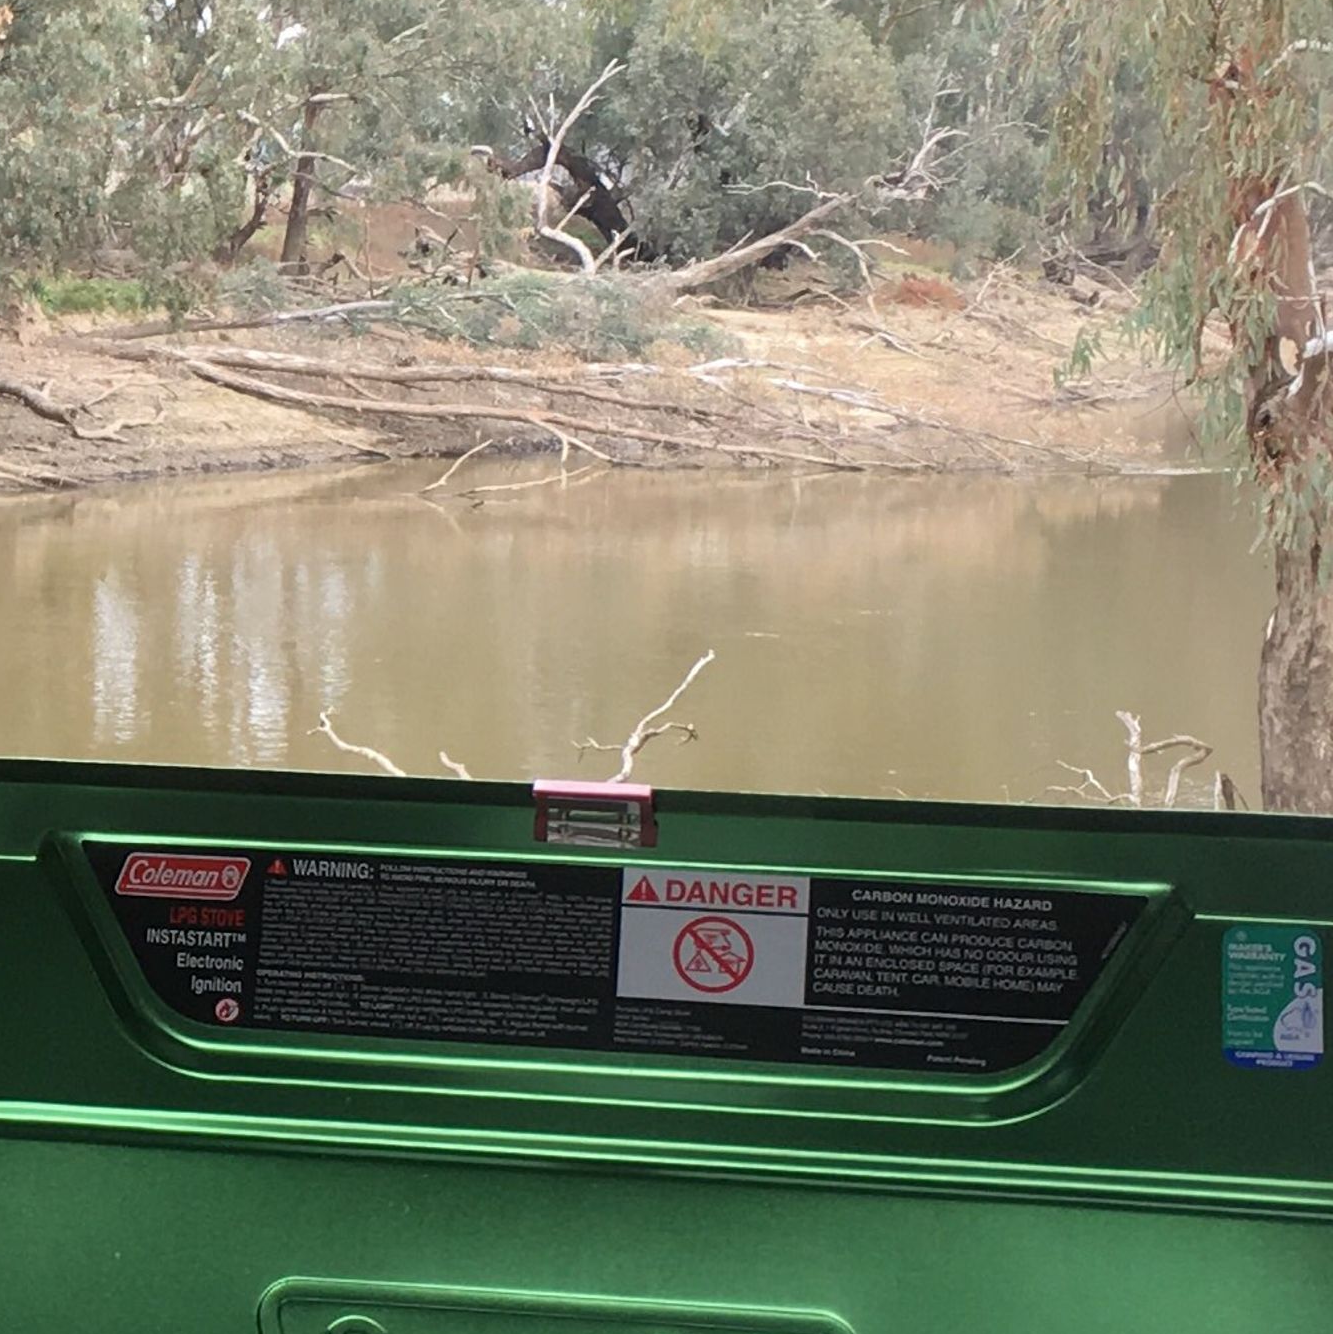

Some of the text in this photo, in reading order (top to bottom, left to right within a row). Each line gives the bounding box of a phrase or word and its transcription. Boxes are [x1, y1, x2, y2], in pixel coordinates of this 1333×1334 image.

[129, 860, 219, 888] Coleman
[292, 859, 374, 880] WARNING:
[665, 879, 798, 908] DANGER
[851, 889, 1052, 911] CARBON MONOXIDE HAZARD
[169, 906, 245, 927] LPG STOVE
[816, 906, 849, 919] ONLY
[852, 908, 878, 921] USE
[881, 910, 894, 922] IN
[896, 911, 931, 924] WELL
[933, 913, 1011, 928] VENTILATED
[816, 925, 1073, 952] THIS APPLIANCE CAN PRODUCE CARBON
[176, 952, 244, 971] Electronic
[814, 953, 826, 965] IT
[829, 955, 842, 966] IN
[844, 956, 863, 967] AN
[865, 956, 935, 972] ENCLOSED
[938, 960, 979, 974] SPACE
[982, 964, 1014, 976] (FOR
[888, 944, 932, 957] WHICH
[934, 947, 961, 960] HAS
[963, 949, 983, 961] NO
[1037, 953, 1078, 966] USING
[1293, 936, 1318, 998] GAS
[191, 975, 242, 995] Ignition
[813, 981, 854, 995] CAUSE
[943, 975, 991, 989] MOBILE
[992, 978, 1035, 994] HOME)
[1036, 981, 1064, 993] MAY
